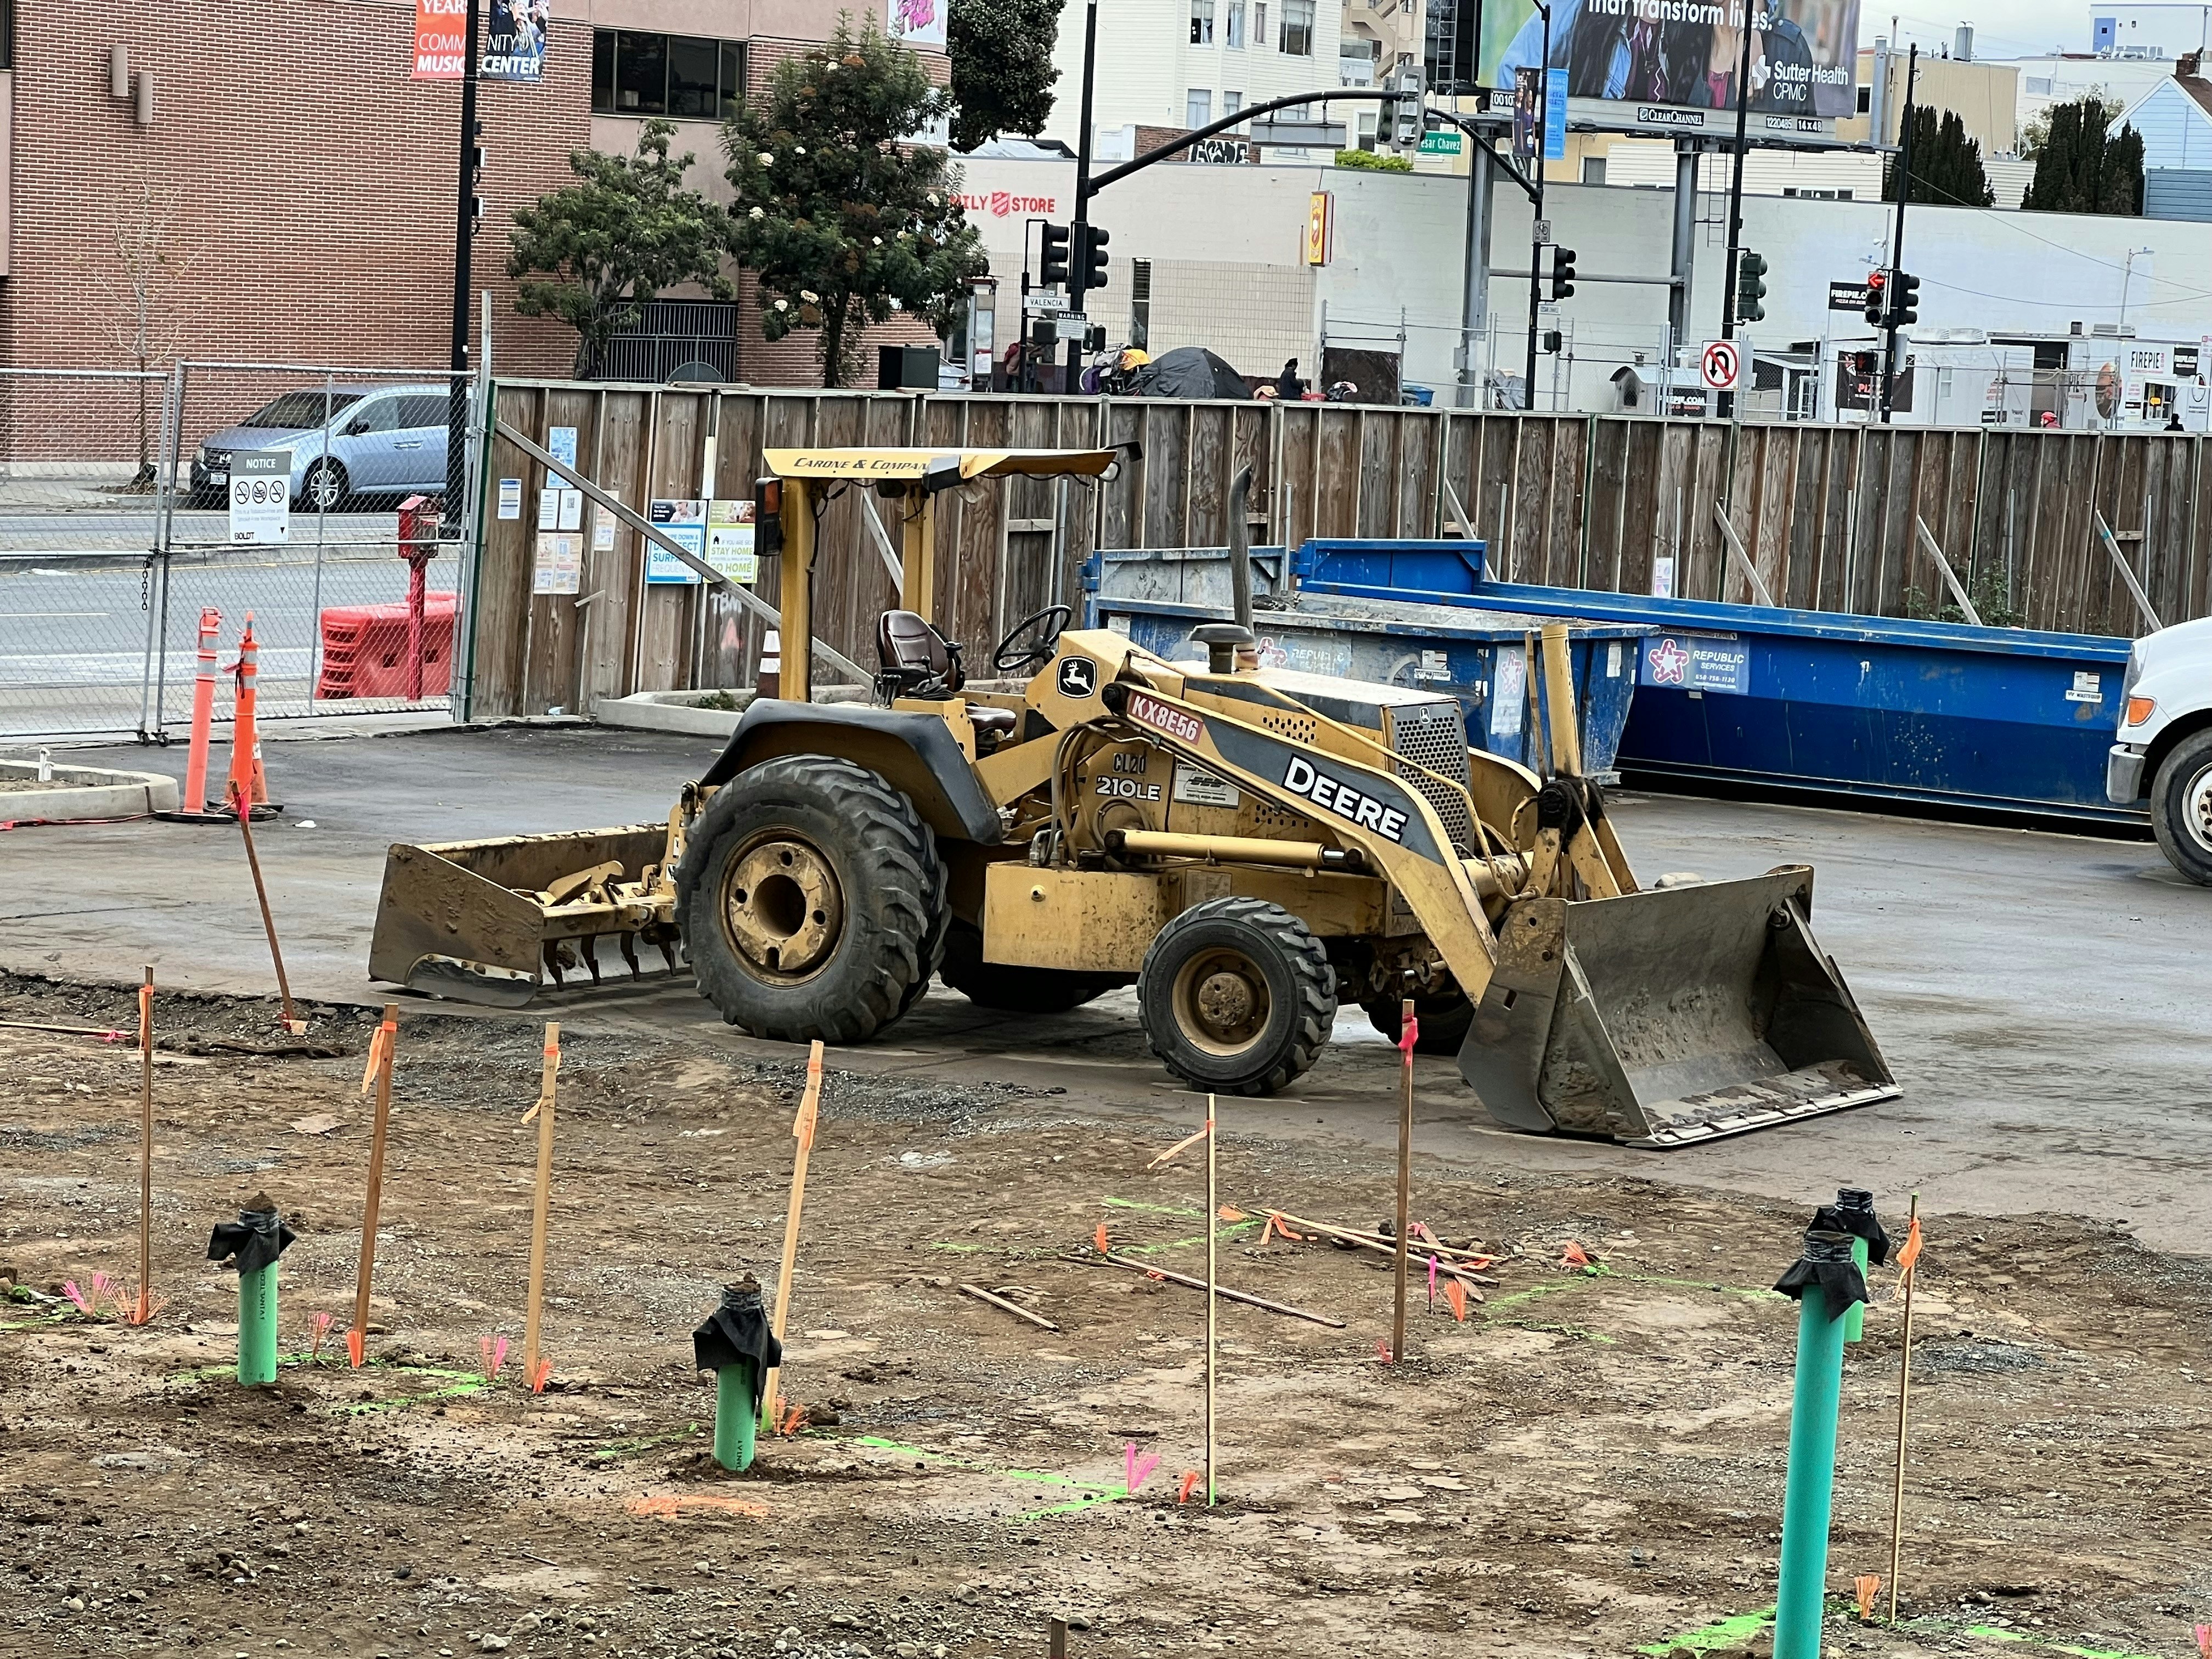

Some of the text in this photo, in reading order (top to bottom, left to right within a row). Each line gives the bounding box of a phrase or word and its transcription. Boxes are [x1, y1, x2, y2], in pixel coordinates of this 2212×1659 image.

[423, 0, 467, 14] YEAR
[1633, 0, 1724, 26] transform
[416, 55, 540, 75] MUSIC CENTER
[1774, 60, 1849, 86] Sutter Health
[1773, 82, 1807, 101] CPMC
[1421, 137, 1460, 150] esar Chavez
[1012, 197, 1056, 213] STORE
[1030, 298, 1063, 307] VALENCIA
[1058, 312, 1085, 320] WARNING
[2131, 351, 2160, 369] FIREPIE
[246, 458, 276, 469] NOTICE
[793, 458, 931, 470] CARONE & COMPAN
[711, 547, 753, 556] STAY HOME
[725, 563, 752, 573] HOME
[1693, 650, 1745, 664] REPUBLIC
[1701, 662, 1735, 672] SERVICES
[1132, 695, 1199, 741] KX8E56
[1096, 776, 1161, 801] 210LE
[1284, 756, 1407, 842] DEERE
